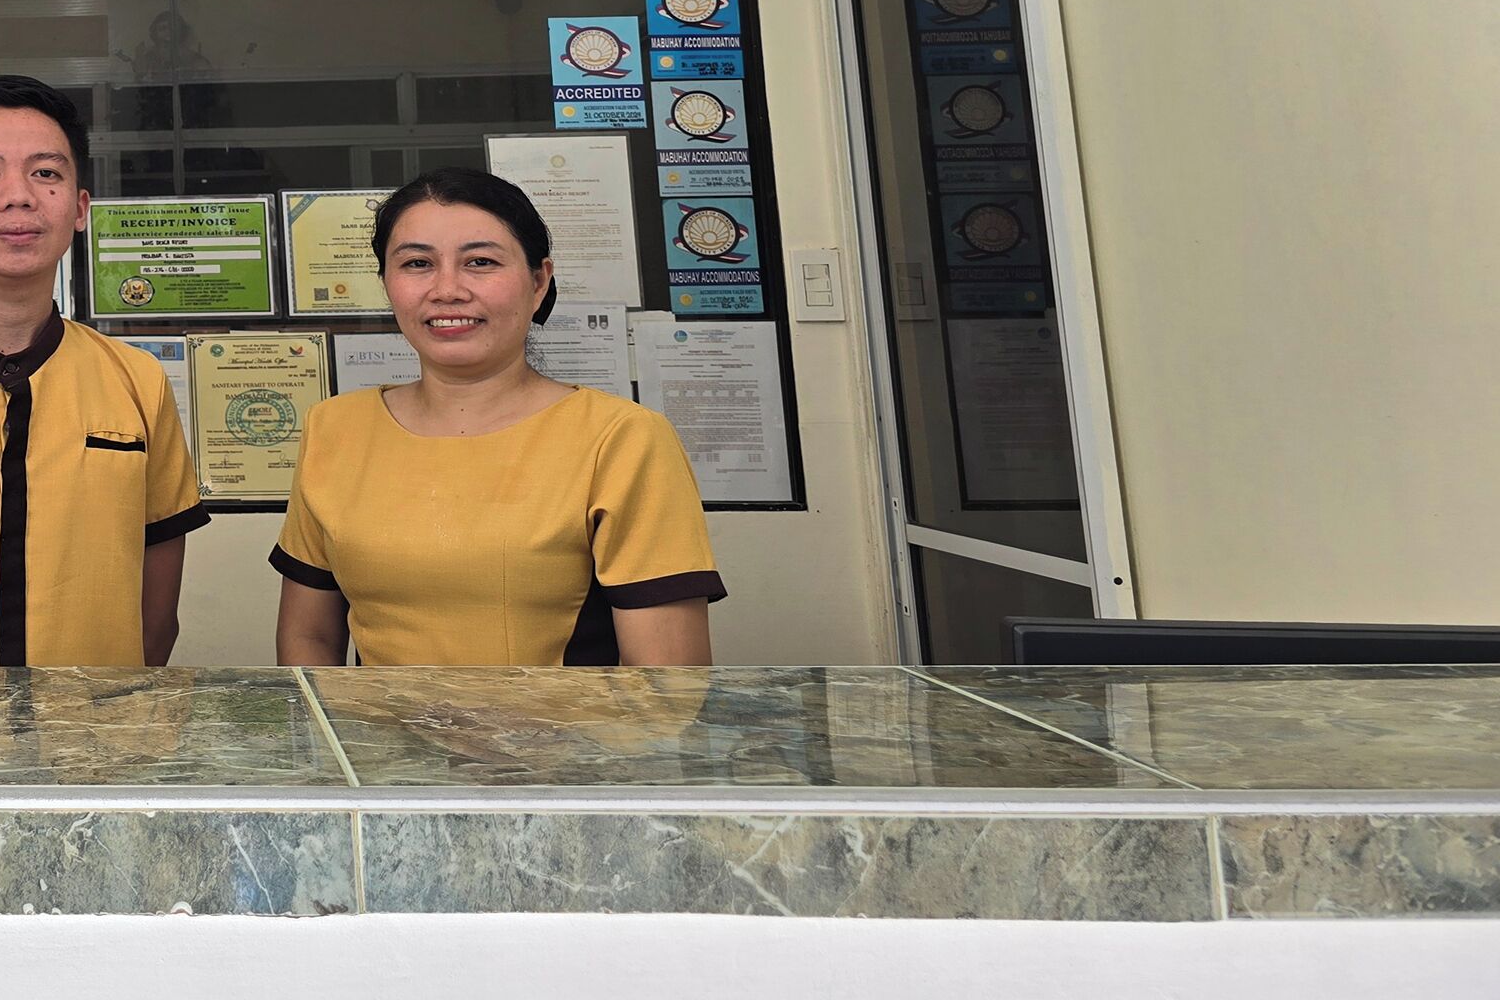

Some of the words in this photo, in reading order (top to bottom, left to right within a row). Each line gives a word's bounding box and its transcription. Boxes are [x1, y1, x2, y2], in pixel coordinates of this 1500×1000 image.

[651, 38, 682, 48] MABUHAY
[684, 37, 740, 48] ACCOMMODATION
[556, 87, 641, 100] ACCREDITED
[660, 152, 690, 163] MABUHAY
[692, 151, 748, 162] ACCOMMODATION
[190, 205, 225, 214] MUST
[120, 218, 237, 228] RECEIPT/INVOICE
[669, 272, 700, 283] MABUHAY
[701, 271, 760, 283] ACCOMMODATIONS
